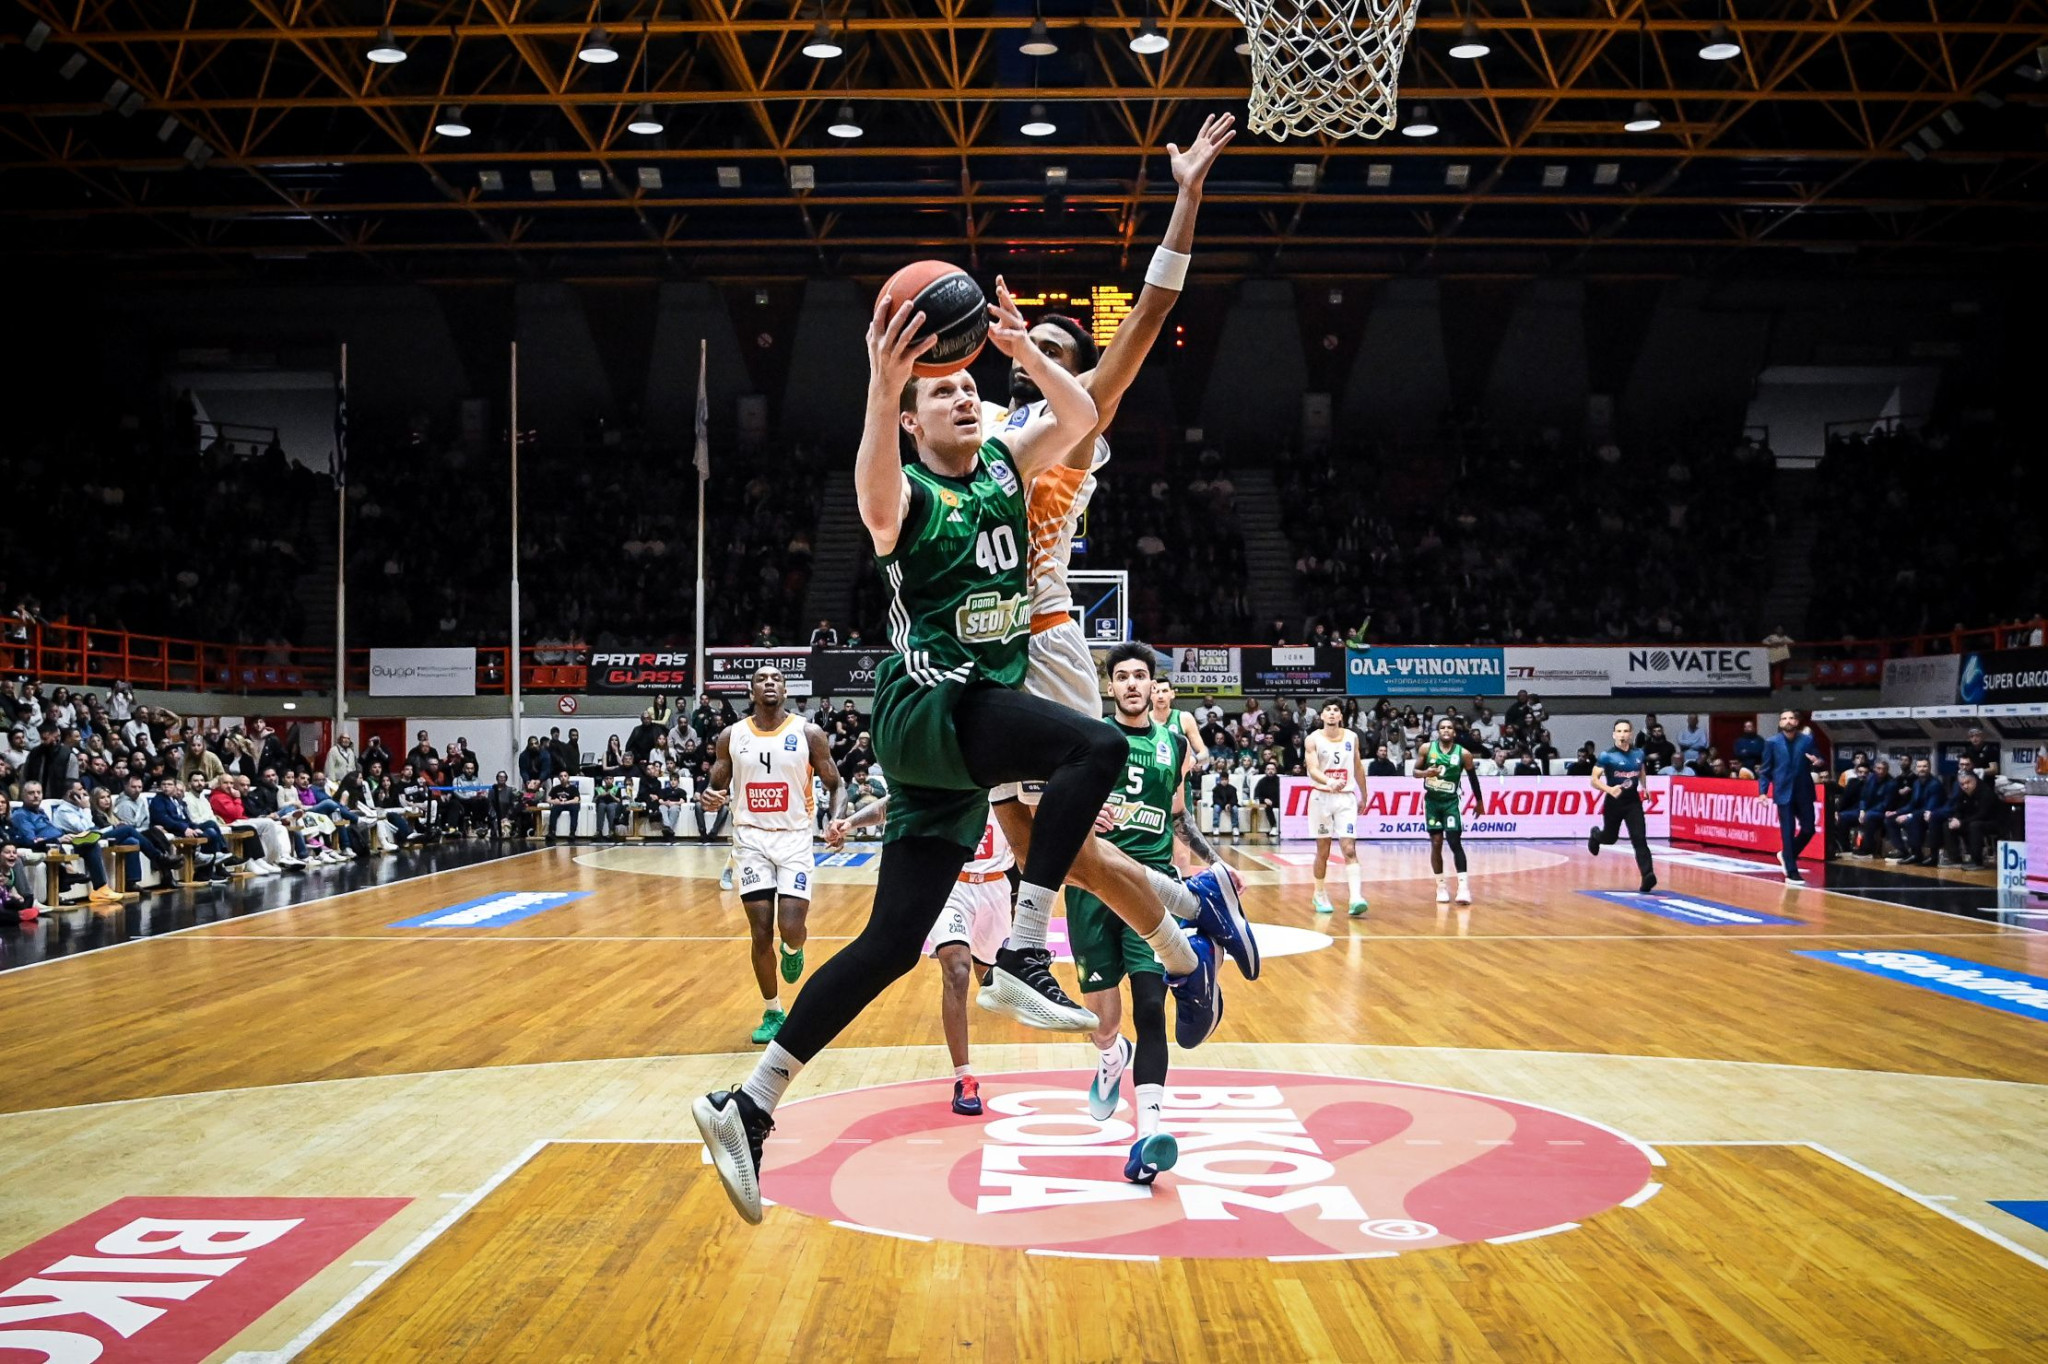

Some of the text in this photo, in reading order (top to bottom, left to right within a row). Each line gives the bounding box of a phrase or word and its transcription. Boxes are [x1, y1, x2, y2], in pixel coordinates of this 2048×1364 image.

[975, 525, 1019, 575] 40
[1199, 656, 1228, 666] TAXI
[1350, 658, 1500, 675] ΟΛΑ-ΨΗΝΟΝΤΑΙ
[1629, 651, 1752, 671] NOVATEC
[609, 671, 685, 683] GLASS
[1174, 675, 1239, 683] 2610 205 205
[1707, 672, 1753, 681] engineering
[1983, 670, 2048, 690] SUPER CARGO
[760, 752, 771, 774] 4
[1333, 751, 1341, 765] 5
[1126, 766, 1145, 795] 5
[749, 788, 784, 799] ΒΙΚΟΣ
[751, 798, 782, 808] COLA
[976, 1090, 1154, 1215] COLA
[1161, 1085, 1369, 1221] ΒΙΚΟΣ
